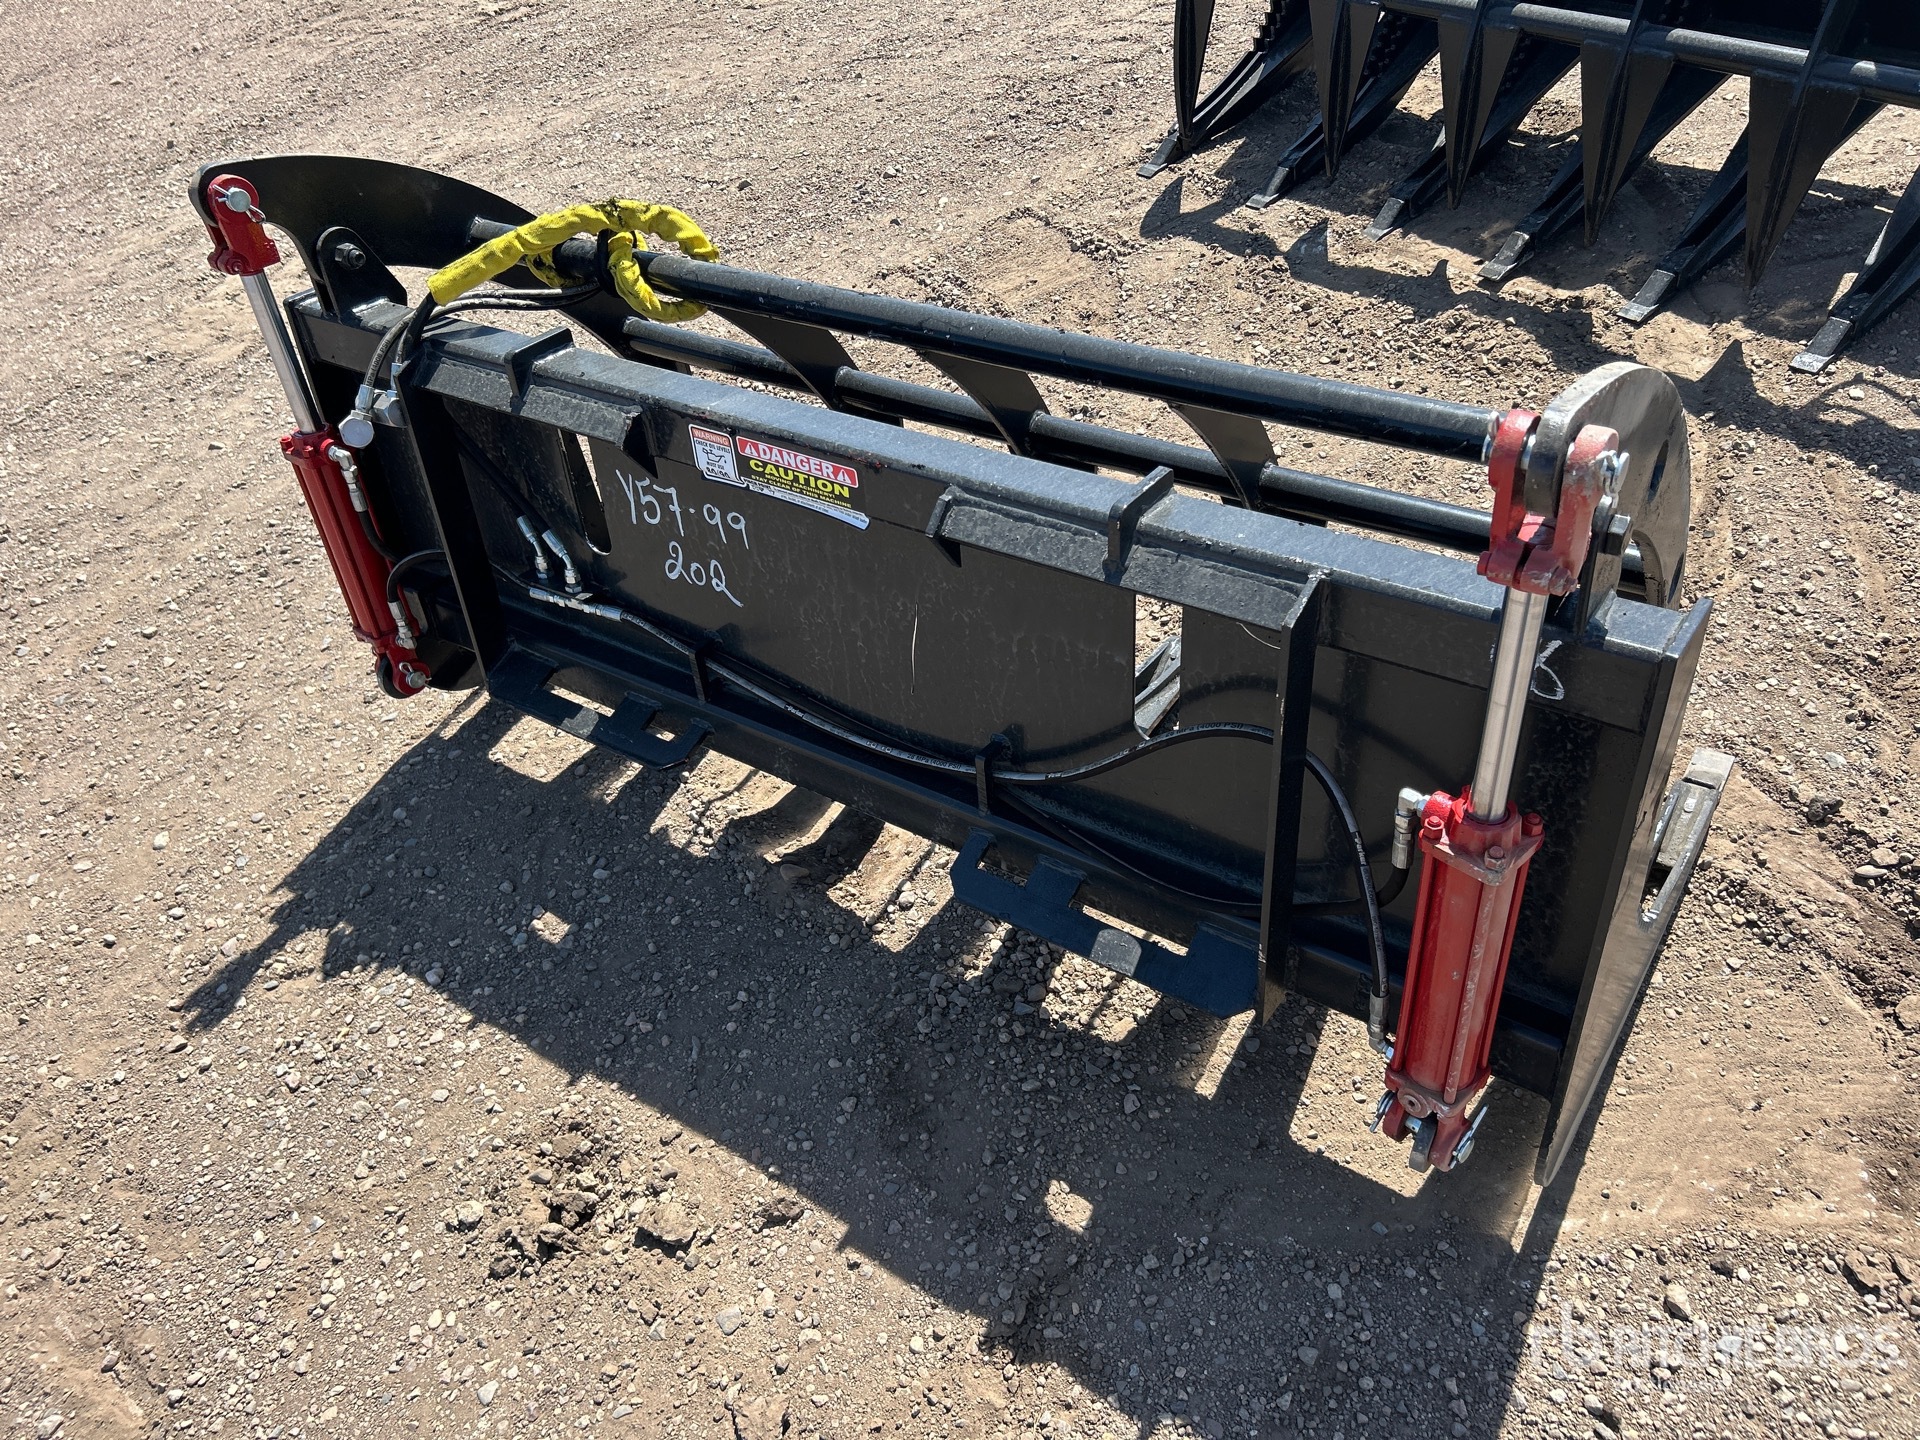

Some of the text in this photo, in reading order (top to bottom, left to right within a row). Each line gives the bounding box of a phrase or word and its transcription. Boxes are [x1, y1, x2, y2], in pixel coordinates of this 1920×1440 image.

[693, 429, 729, 445] WARNING
[695, 439, 708, 447] CHECK
[716, 445, 731, 454] LEVELS
[749, 459, 850, 498] CAUTION
[757, 443, 836, 480] DANGER
[751, 474, 768, 483] STAY
[769, 479, 790, 490] CLEAR
[803, 490, 818, 499] THIS
[820, 494, 852, 508] MACHINE
[765, 474, 836, 498] MOVING MACHINERY!
[665, 540, 744, 608] 202
